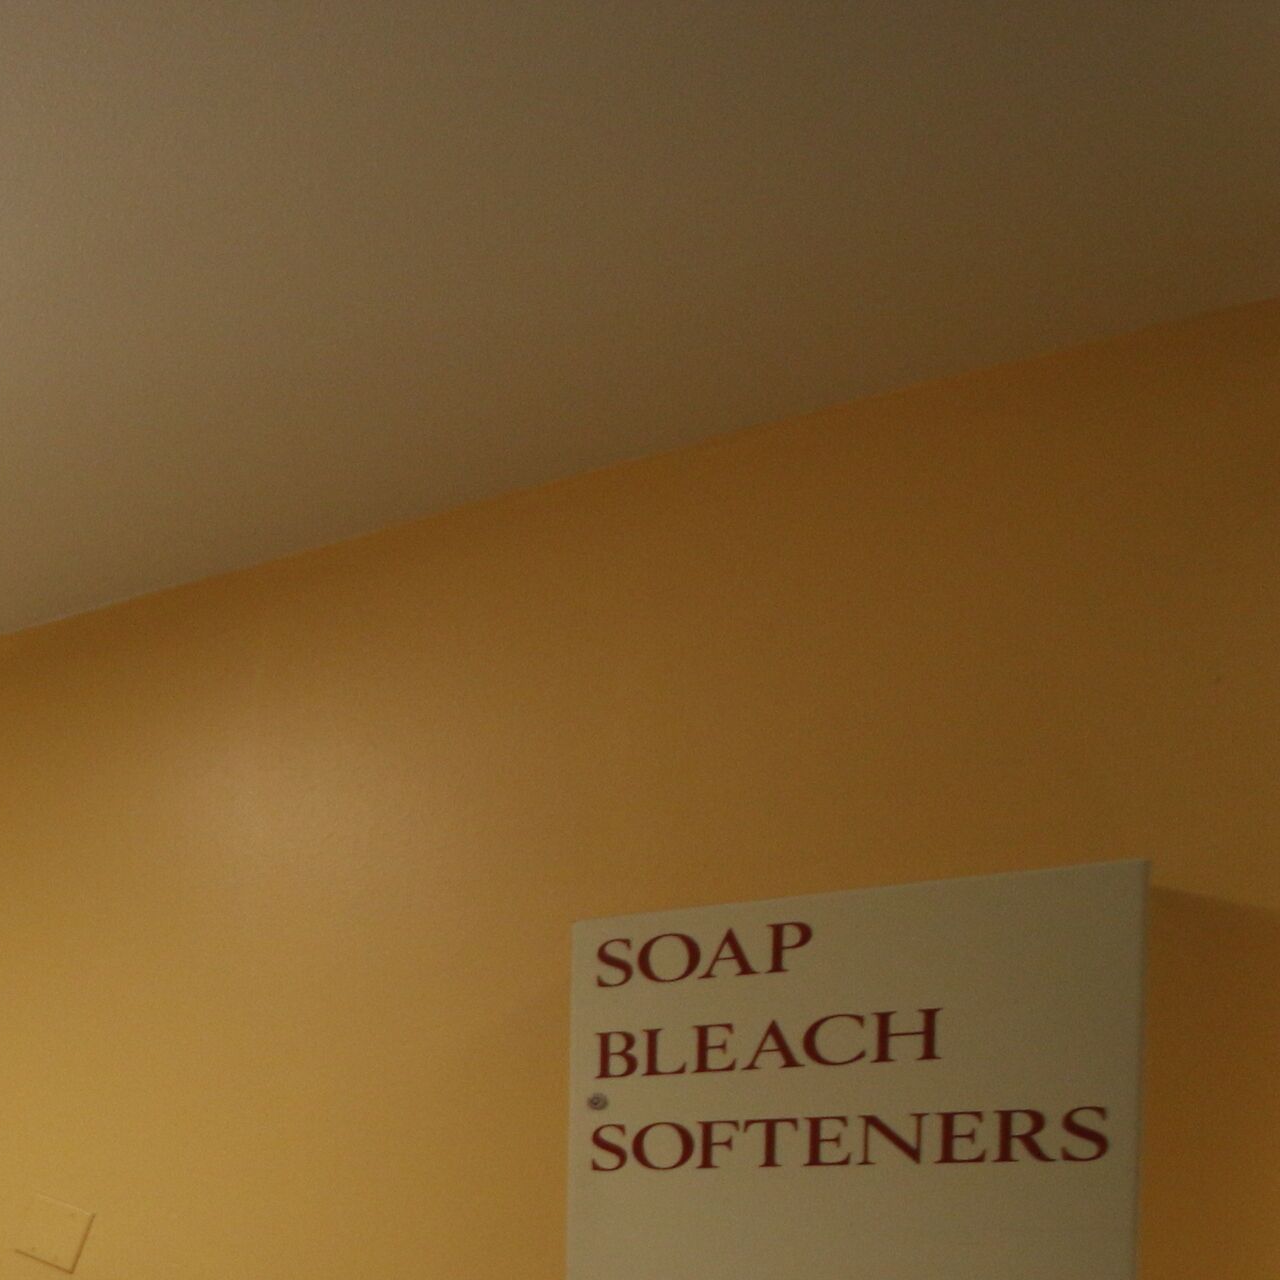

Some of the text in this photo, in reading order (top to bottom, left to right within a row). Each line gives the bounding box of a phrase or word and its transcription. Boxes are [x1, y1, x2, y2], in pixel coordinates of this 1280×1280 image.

[595, 920, 814, 989] SOAP
[593, 1006, 944, 1080] BLEACH
[590, 1105, 1112, 1173] SOFTENERS
